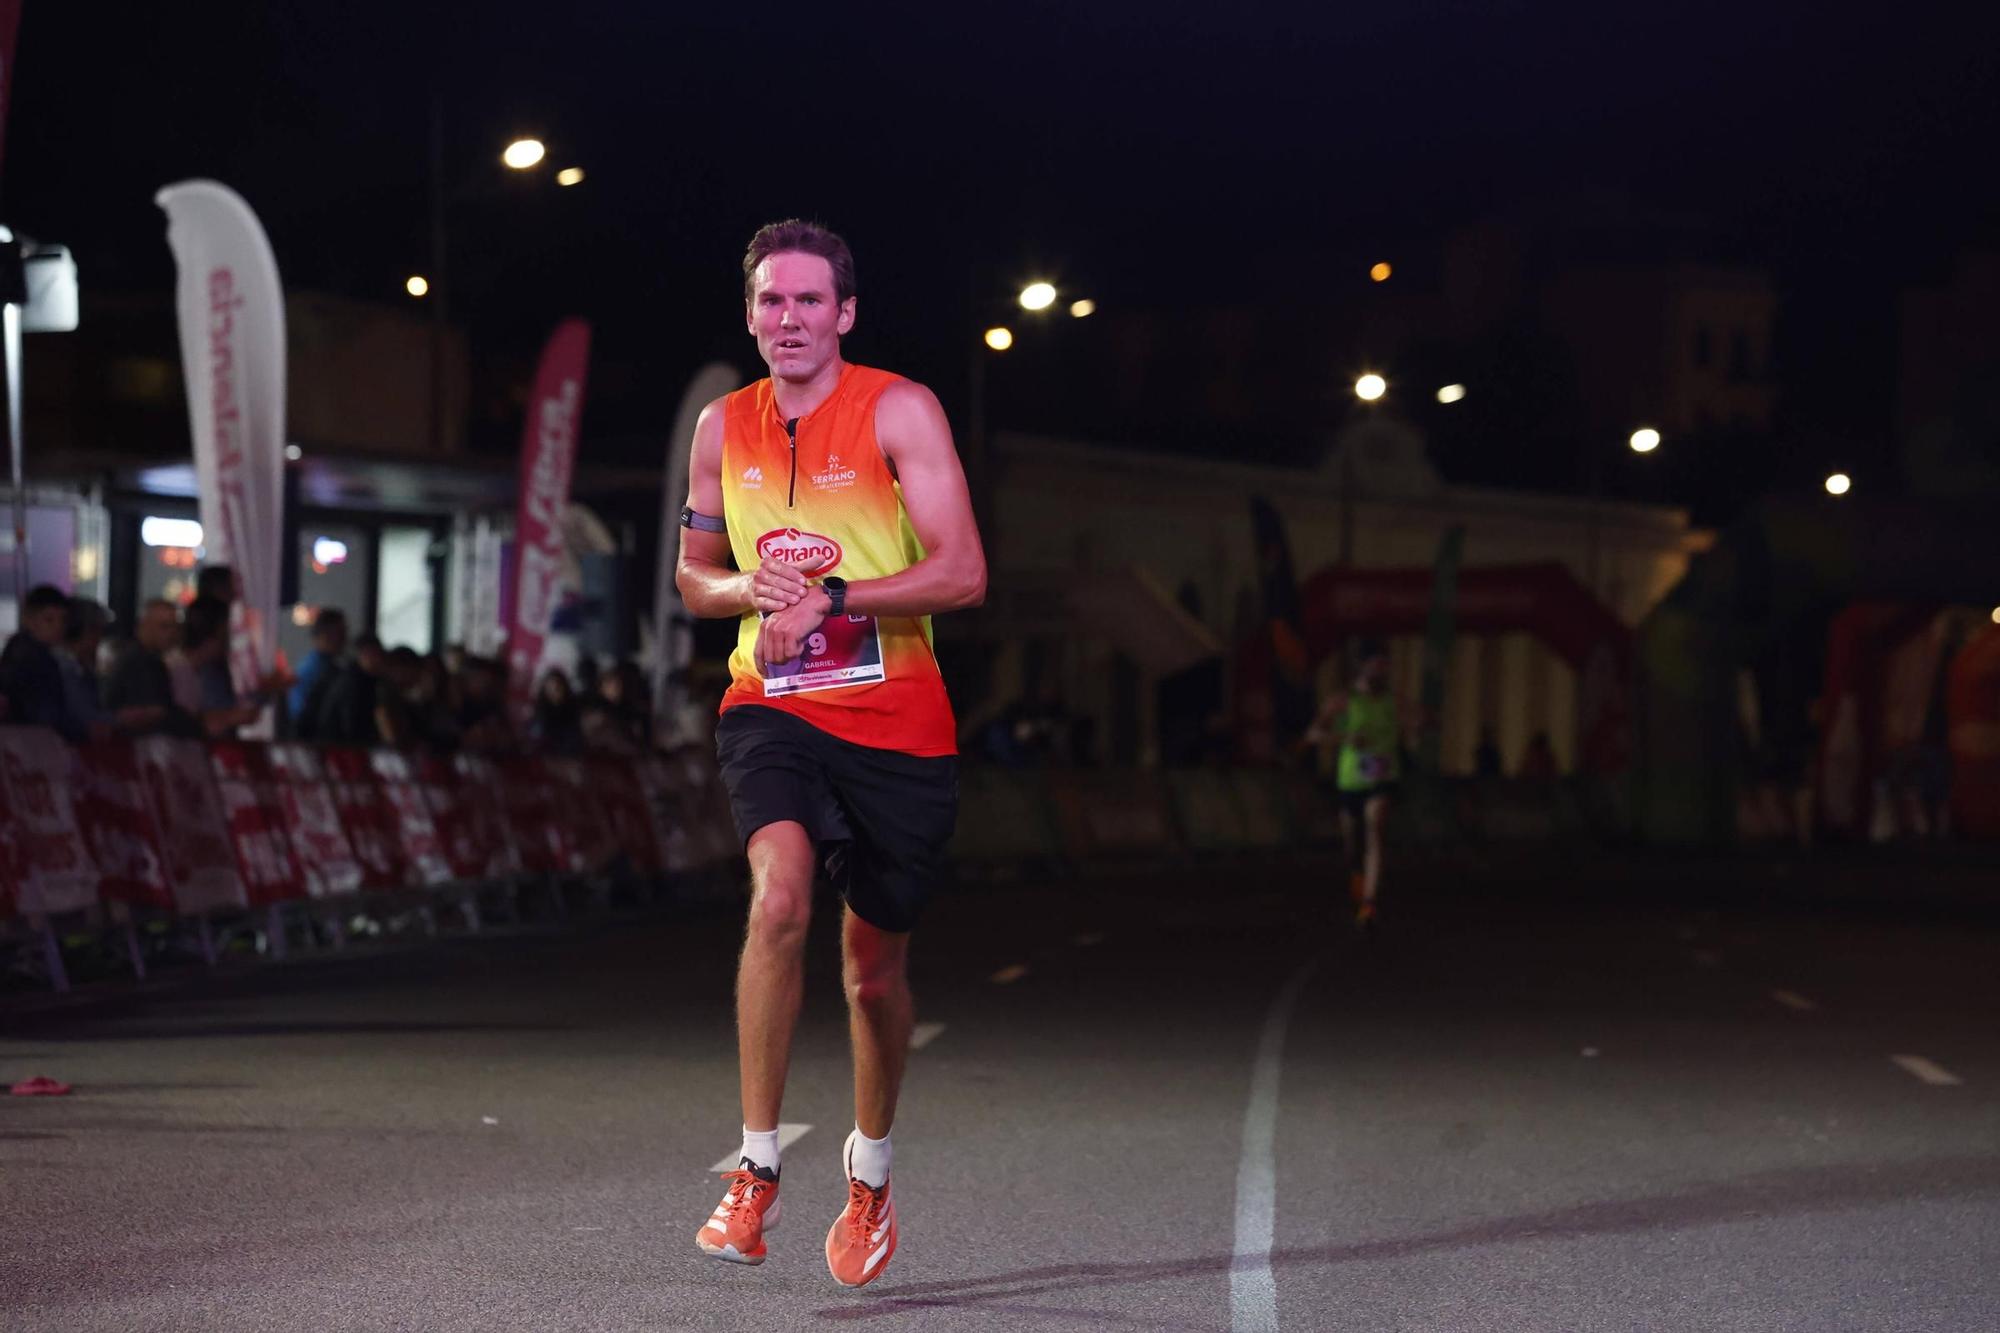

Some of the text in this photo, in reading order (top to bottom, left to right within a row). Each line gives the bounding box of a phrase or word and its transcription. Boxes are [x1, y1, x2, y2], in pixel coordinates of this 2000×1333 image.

[811, 470, 856, 485] SERRANO
[808, 632, 827, 655] 9
[804, 660, 837, 670] GABRIEL
